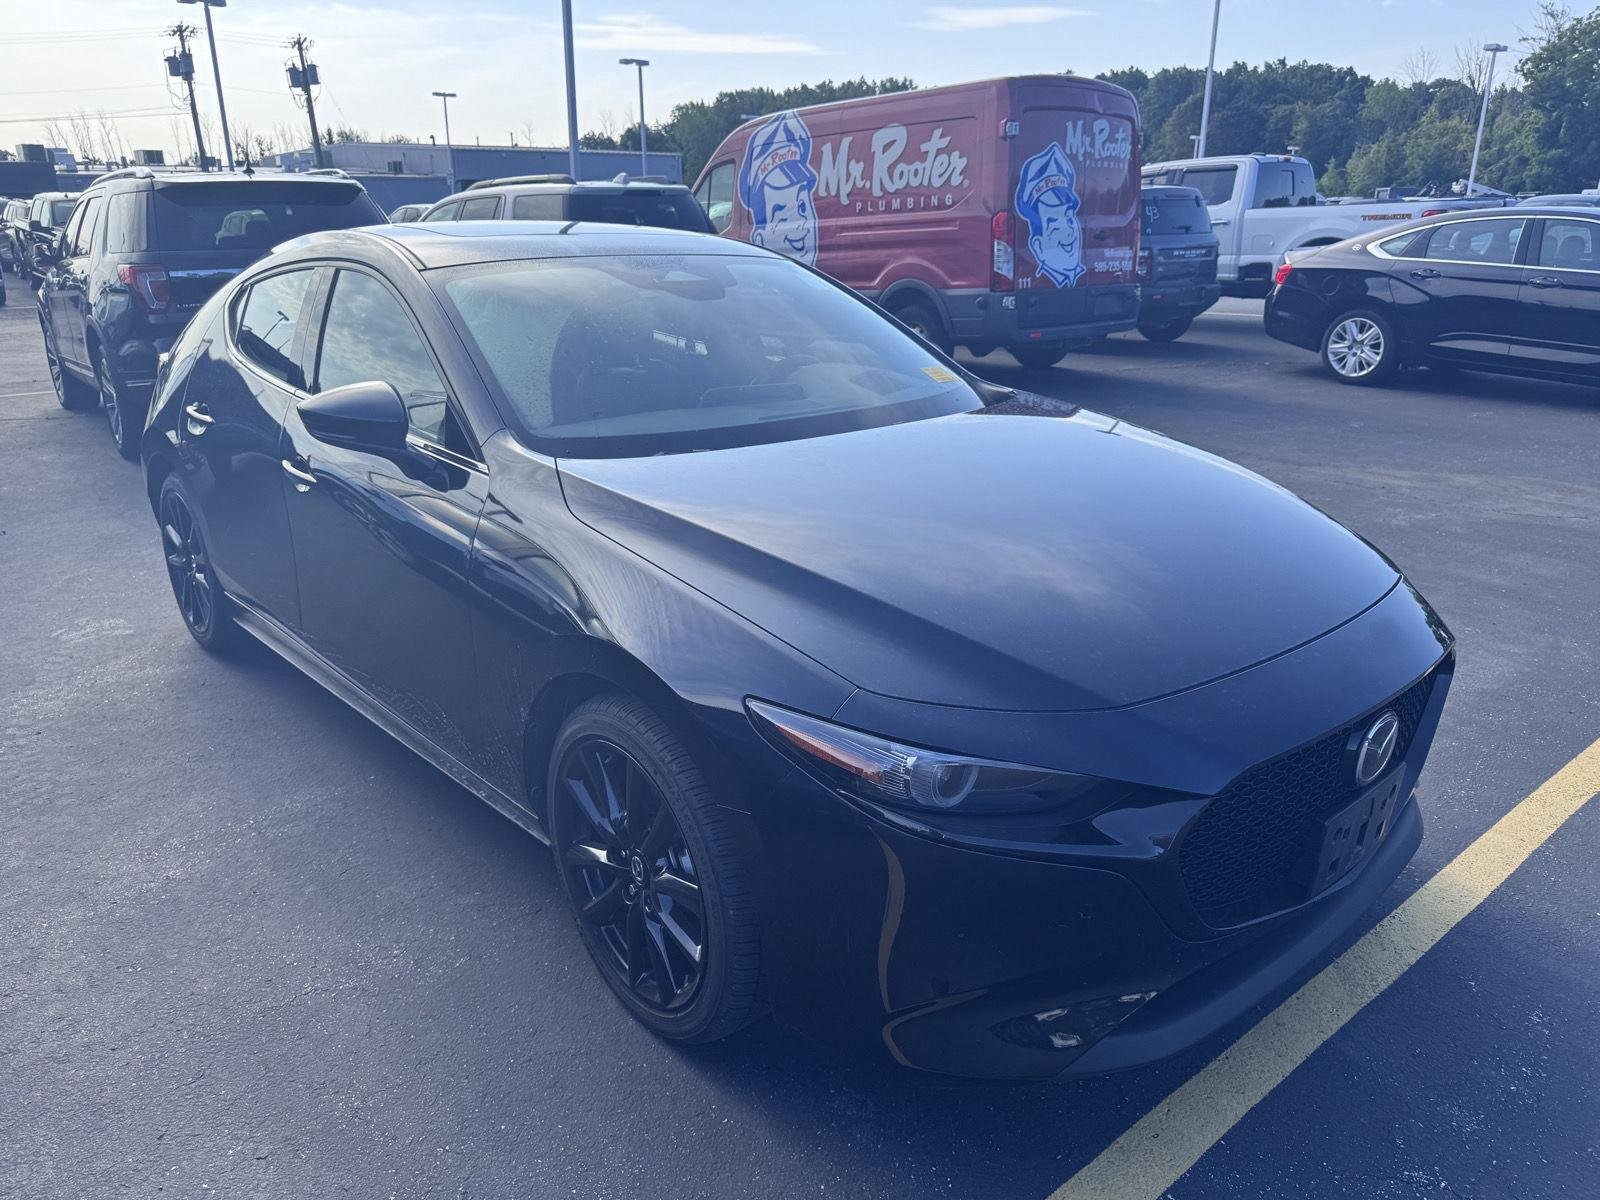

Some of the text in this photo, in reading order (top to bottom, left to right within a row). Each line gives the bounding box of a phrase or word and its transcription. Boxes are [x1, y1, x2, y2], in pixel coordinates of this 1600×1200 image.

[1066, 118, 1132, 161] Mr. Rooter
[818, 123, 967, 205] Mr. Rooter
[856, 195, 953, 213] PLUMBING
